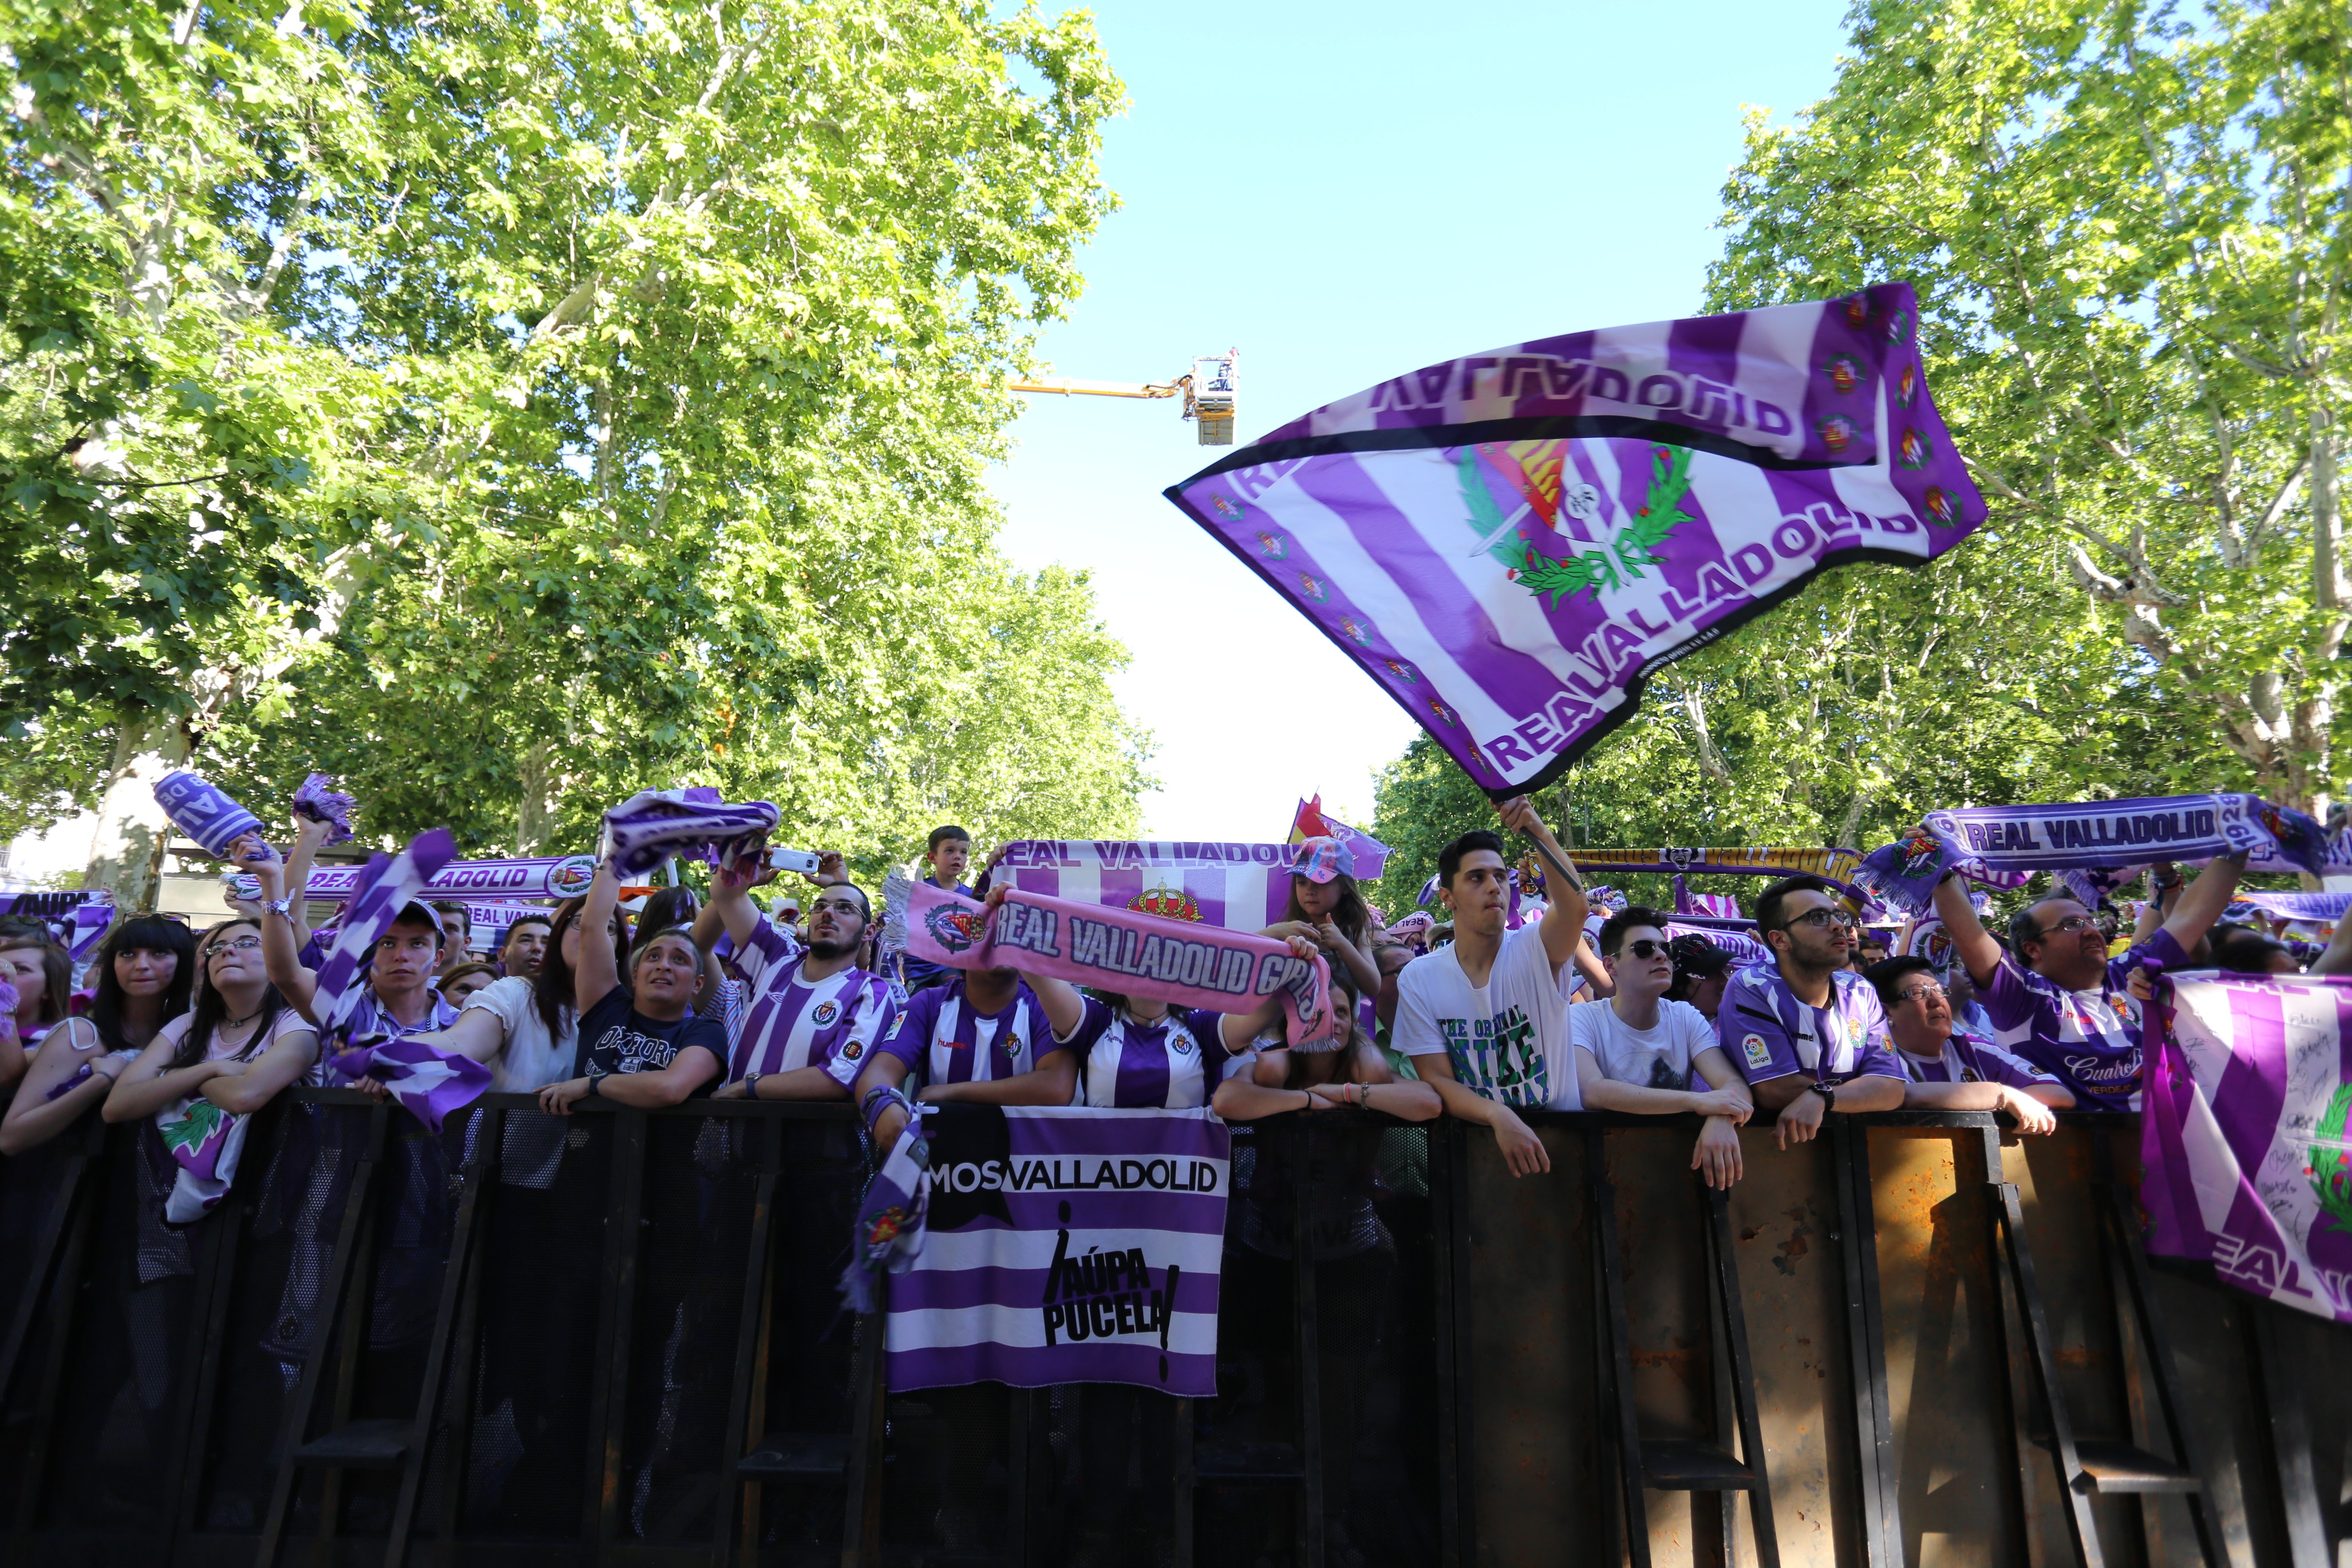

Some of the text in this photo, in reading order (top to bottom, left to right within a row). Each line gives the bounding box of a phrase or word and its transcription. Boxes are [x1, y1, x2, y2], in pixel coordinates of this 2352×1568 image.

[1482, 506, 1917, 773] REAL VALLADOLID
[1965, 808, 2215, 851] REAL VALLADOLID
[2223, 794, 2257, 848] 1928
[994, 900, 1320, 1024] REAL VALLADOLID GIRLS
[938, 1038, 967, 1049] hummel
[1437, 1019, 1468, 1038] THE
[1446, 1021, 1545, 1088] NIKE
[1750, 1055, 1769, 1065] LaLiga
